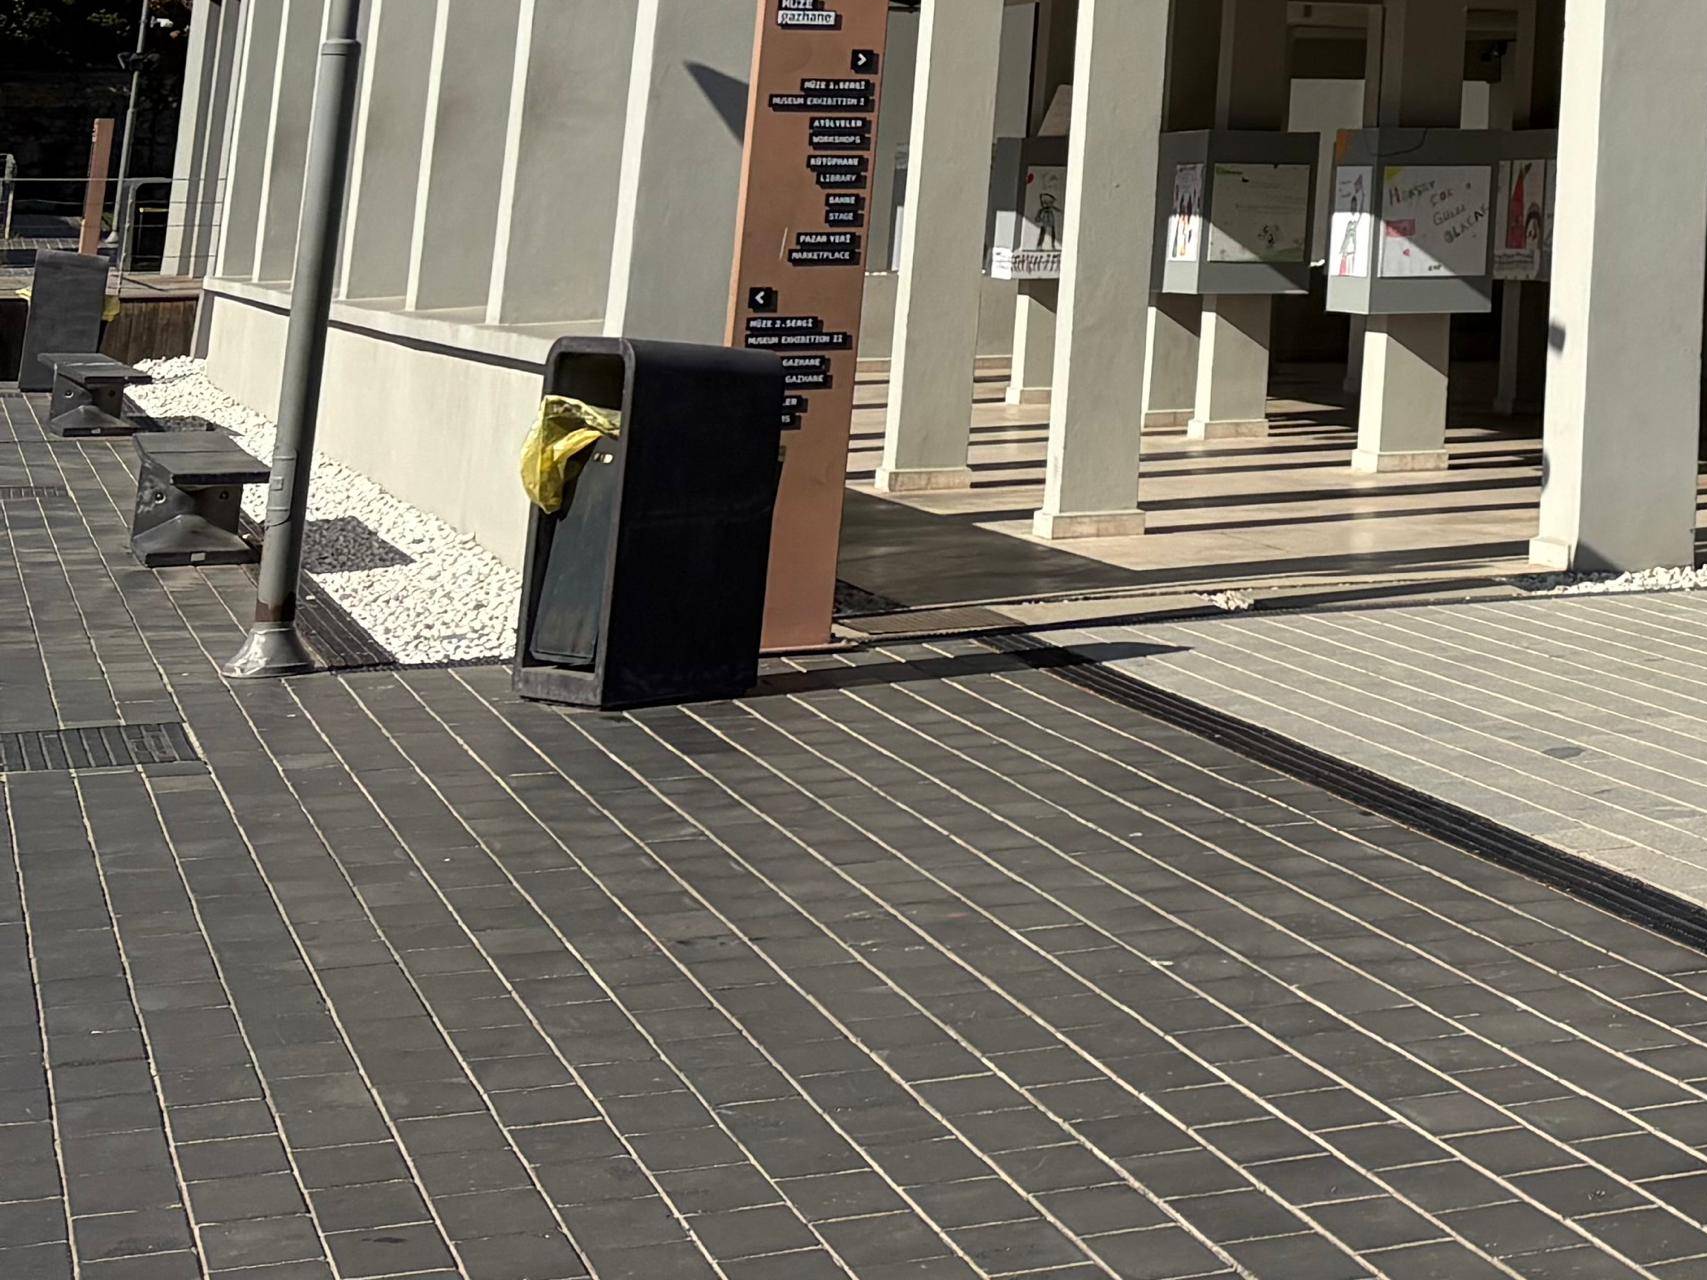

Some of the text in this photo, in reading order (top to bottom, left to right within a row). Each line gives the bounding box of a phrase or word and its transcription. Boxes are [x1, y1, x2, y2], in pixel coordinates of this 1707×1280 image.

[781, 11, 832, 26] gazhane
[820, 174, 857, 182] LIBRARY
[828, 212, 854, 220] STAGE
